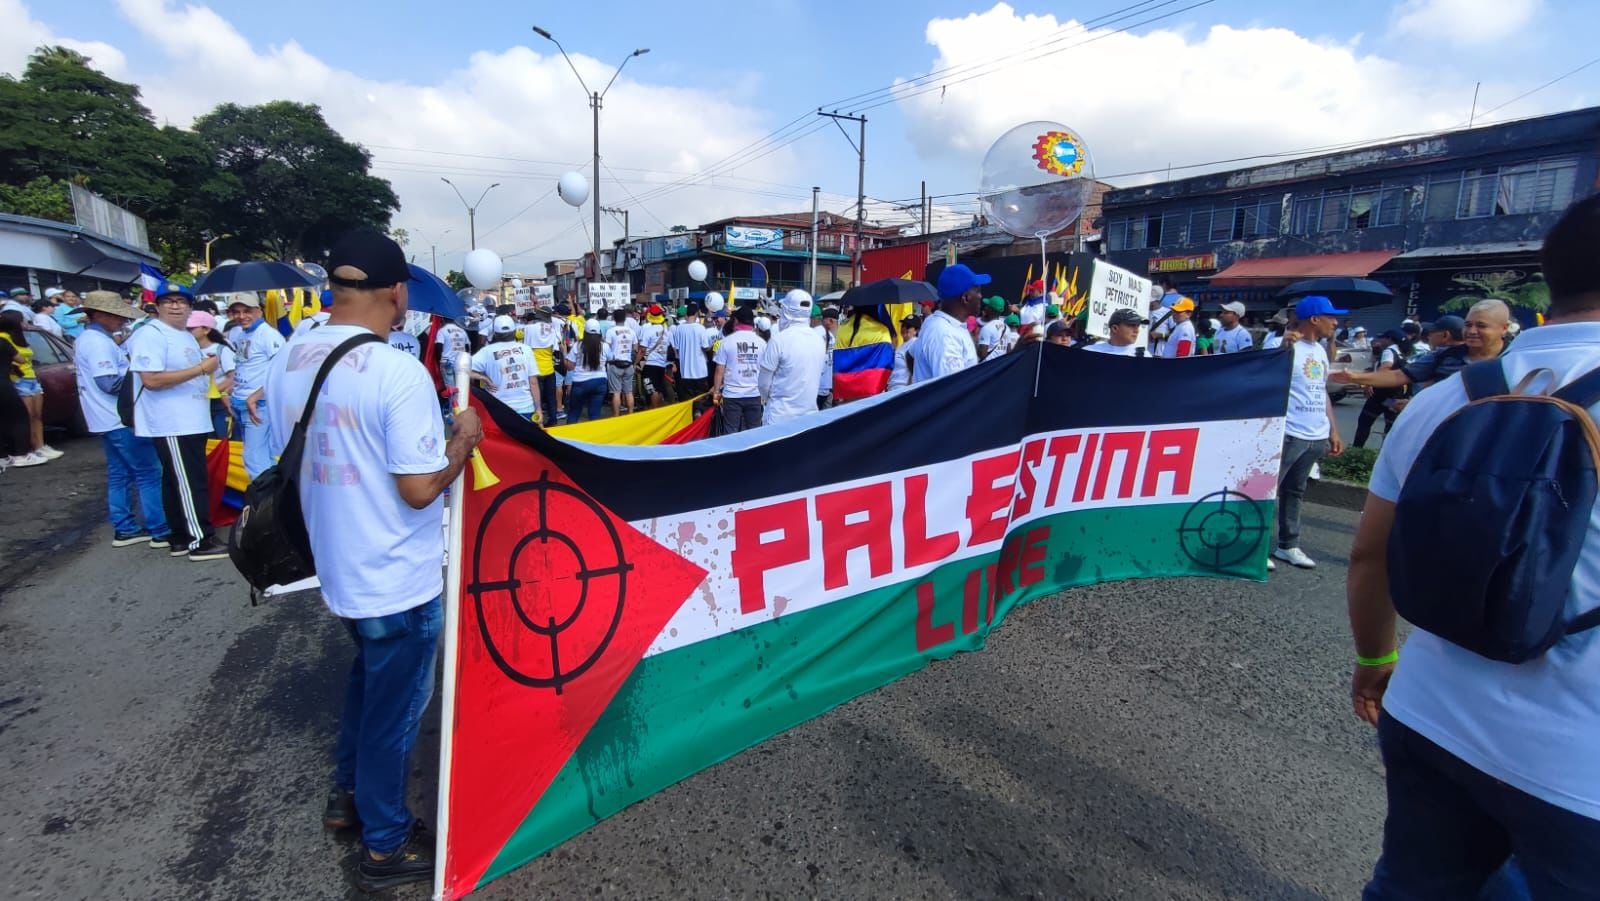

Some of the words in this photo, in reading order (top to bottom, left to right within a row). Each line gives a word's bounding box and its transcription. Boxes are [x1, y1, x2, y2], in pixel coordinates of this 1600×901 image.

[1108, 269, 1123, 286] SOY
[1128, 276, 1142, 293] MAS
[1093, 300, 1107, 317] QUE
[1105, 286, 1139, 309] PETRISTA
[731, 427, 1200, 615] PALESTINA
